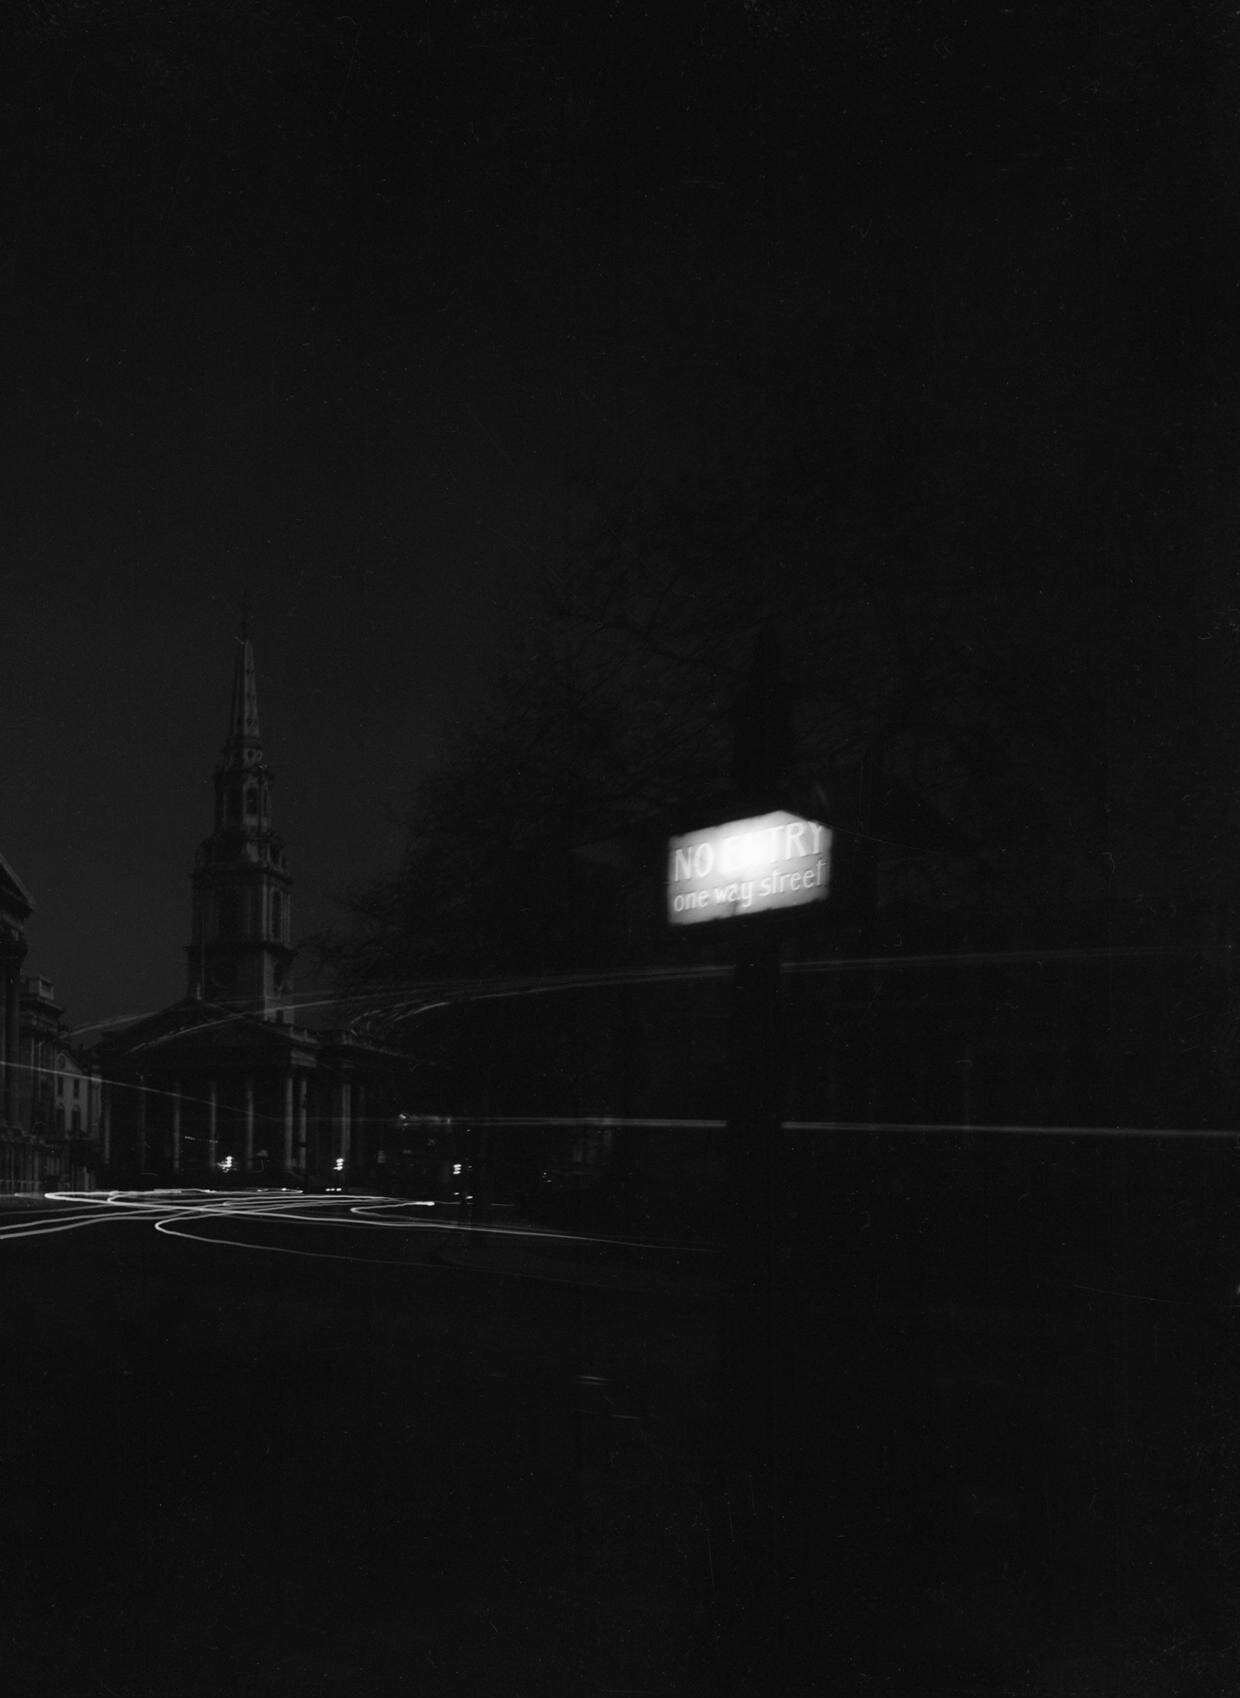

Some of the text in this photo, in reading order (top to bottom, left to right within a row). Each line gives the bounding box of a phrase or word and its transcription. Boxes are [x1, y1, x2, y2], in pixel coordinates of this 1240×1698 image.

[674, 842, 714, 882] NO
[673, 859, 827, 912] one way street
